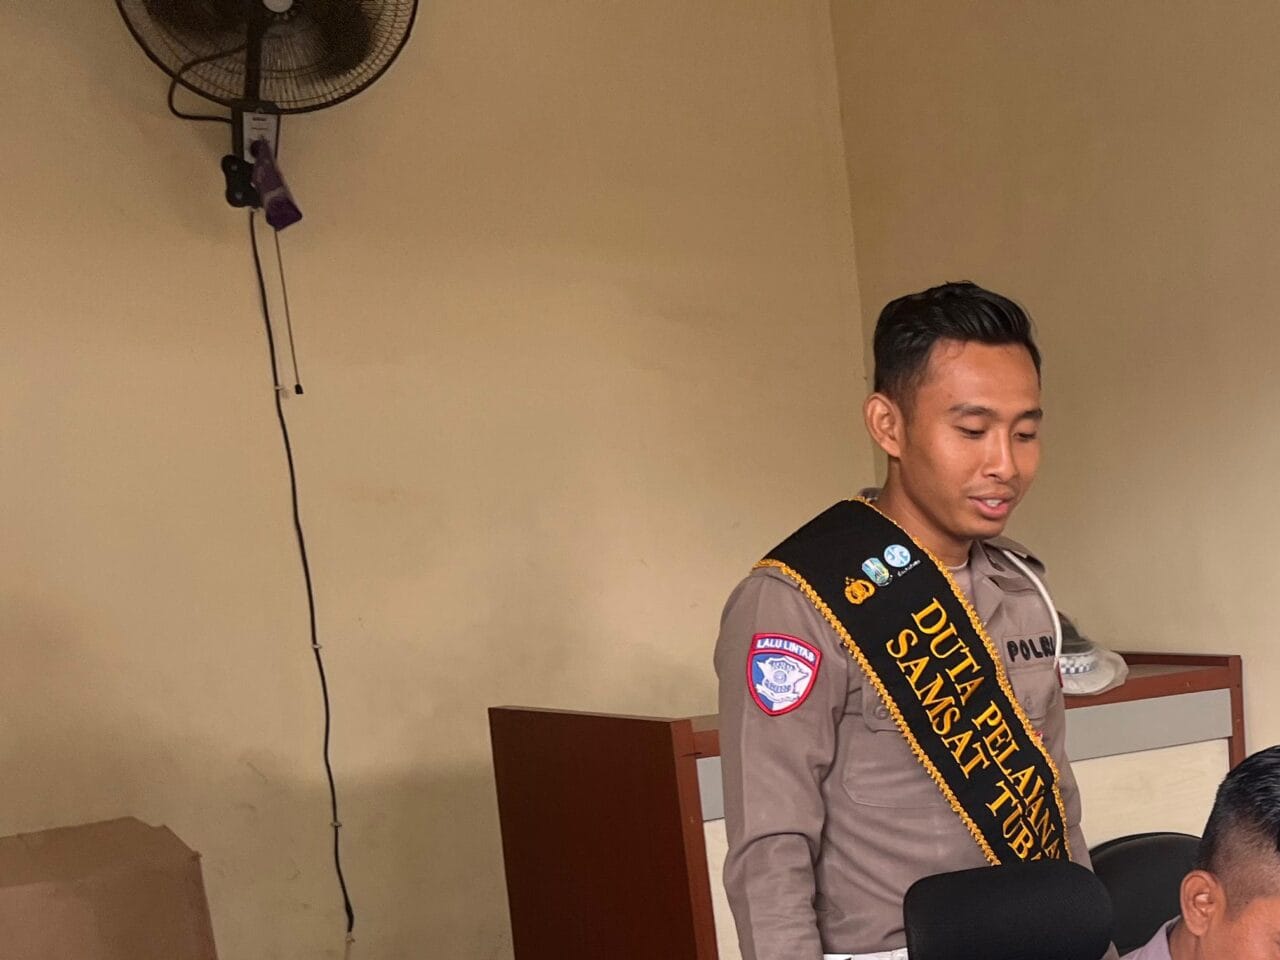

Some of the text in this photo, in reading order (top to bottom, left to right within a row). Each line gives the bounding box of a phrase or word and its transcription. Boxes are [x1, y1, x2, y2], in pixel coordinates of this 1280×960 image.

[756, 638, 816, 663] LALU LINTAS
[886, 628, 990, 780] SAMSAT
[911, 597, 1061, 860] DUTA PELAYANA
